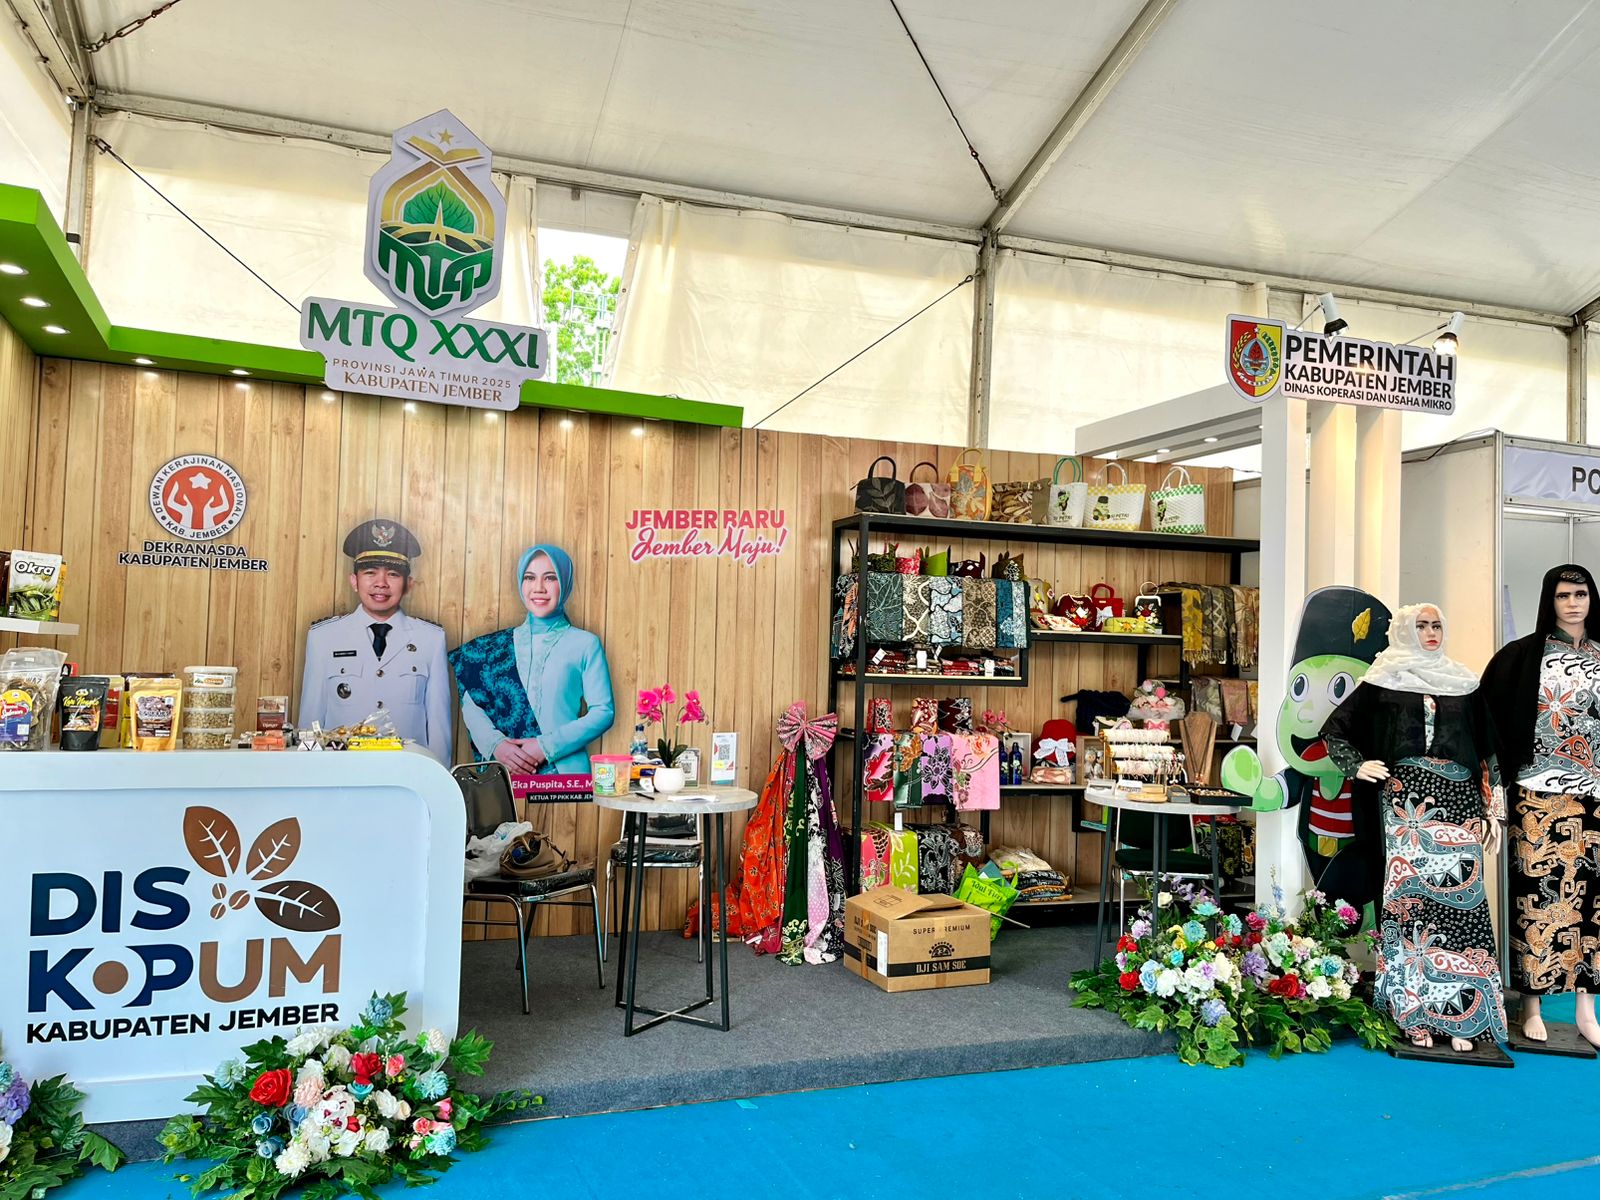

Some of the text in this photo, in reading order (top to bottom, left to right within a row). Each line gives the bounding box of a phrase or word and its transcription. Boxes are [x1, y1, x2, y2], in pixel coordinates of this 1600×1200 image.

[308, 303, 540, 369] MTQ XXXI
[1285, 334, 1453, 381] PEMERINTAH
[333, 358, 512, 389] PROVINSI JAWA TIMUR 2025
[344, 372, 502, 402] KABUPATEN JEMBER
[1285, 363, 1387, 391] KABUPATEN
[1390, 373, 1452, 399] JEMBER
[1285, 382, 1452, 411] DINAS KOPERASI DAN USAHA MIKRO
[152, 457, 244, 518] DEWAN KERAJINAN NASIONAL
[165, 521, 229, 539] KAB. JEMBER
[625, 510, 785, 529] JEMBER BARU
[144, 541, 247, 557] DEKRANASDA
[631, 526, 788, 564] Jember Maju!
[15, 561, 55, 576] Okra
[119, 553, 268, 571] KABUPATEN JEMBER
[512, 781, 528, 789] Eka
[530, 780, 565, 790] Puspita,
[30, 866, 191, 937] DIS
[28, 933, 342, 1013] KOPUM
[916, 960, 967, 974] DJI SAM SOE
[27, 1003, 340, 1044] KABUPATEN JEMBER
